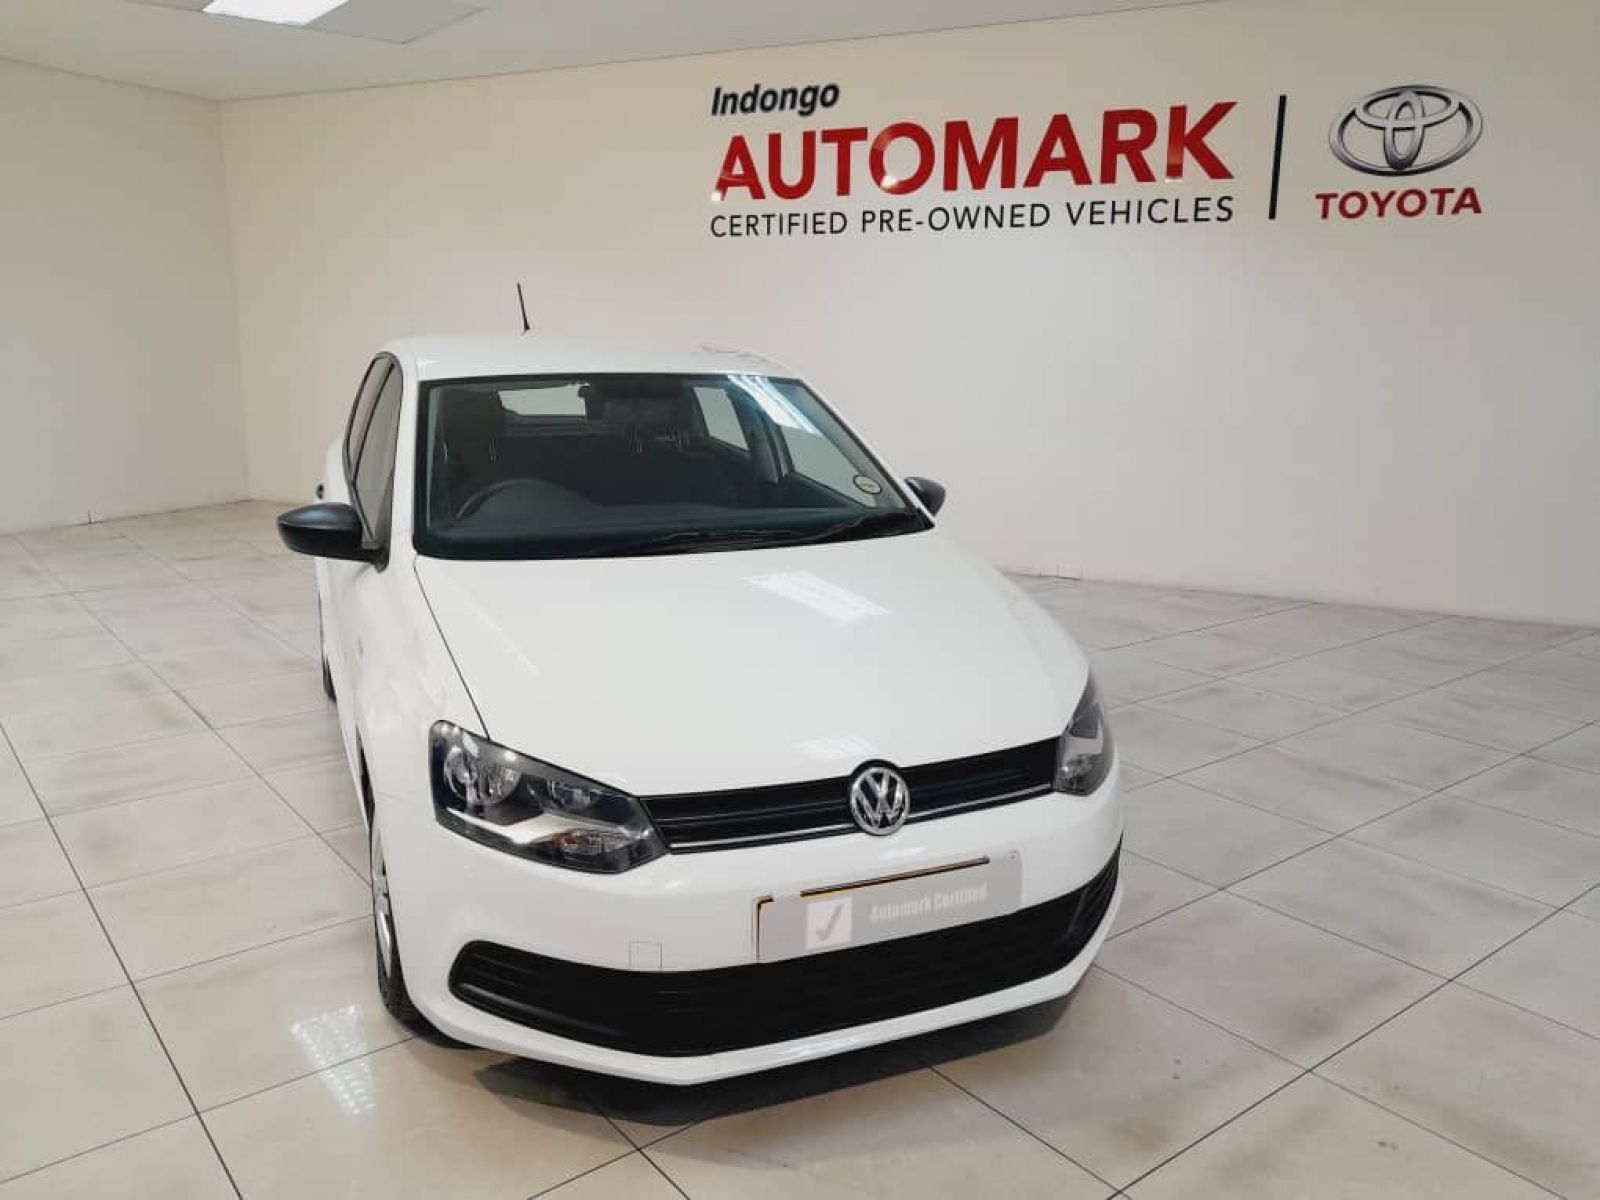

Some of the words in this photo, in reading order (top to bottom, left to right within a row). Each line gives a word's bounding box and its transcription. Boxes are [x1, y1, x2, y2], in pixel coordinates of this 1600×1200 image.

[711, 83, 840, 117] Indongo
[711, 102, 1238, 201] AUTOMARK
[710, 212, 848, 238] CERTIFIED
[861, 202, 1051, 233] PRE-OWNED
[1066, 195, 1235, 227] VEHICLES
[1314, 186, 1482, 220] TOYOTA
